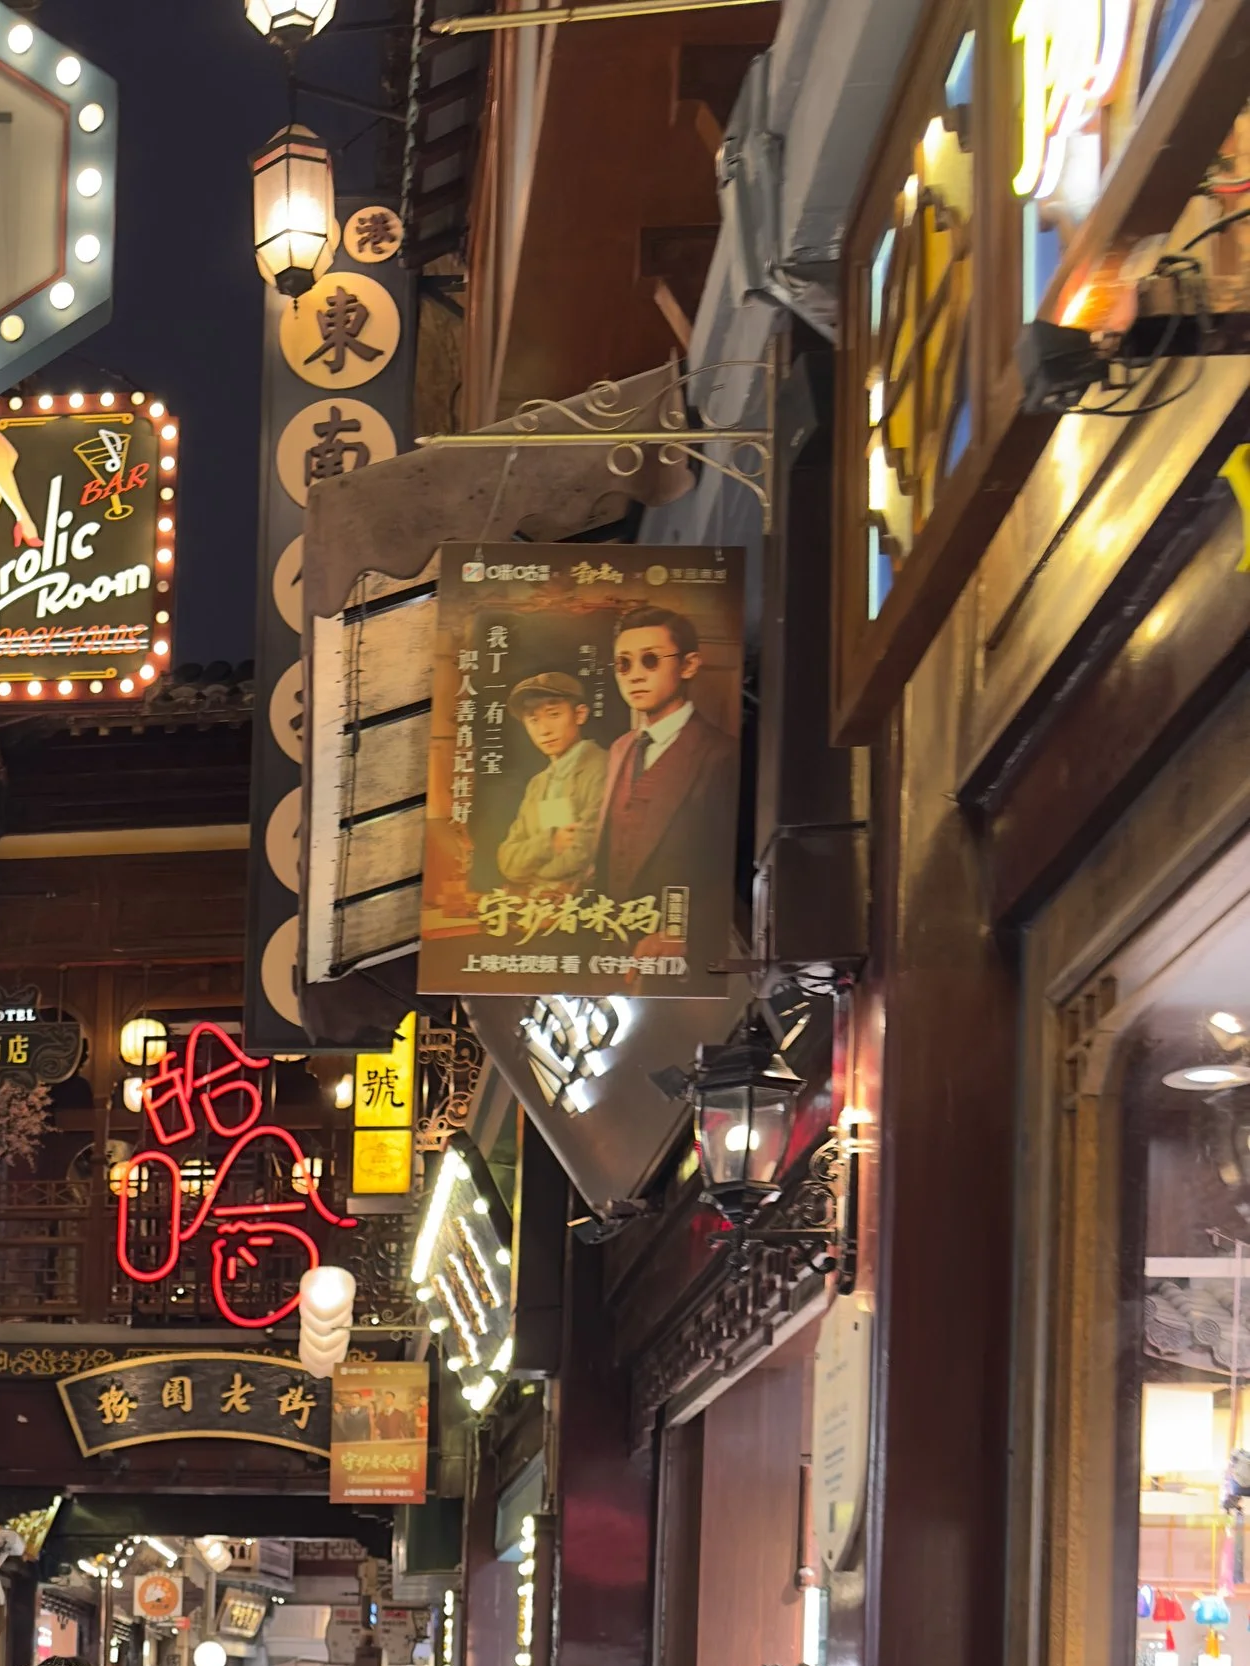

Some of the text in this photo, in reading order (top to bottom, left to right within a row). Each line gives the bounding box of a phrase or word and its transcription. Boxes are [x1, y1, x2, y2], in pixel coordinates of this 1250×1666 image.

[80, 463, 150, 506] BAR
[36, 564, 151, 619] Room
[362, 1066, 406, 1109] 號
